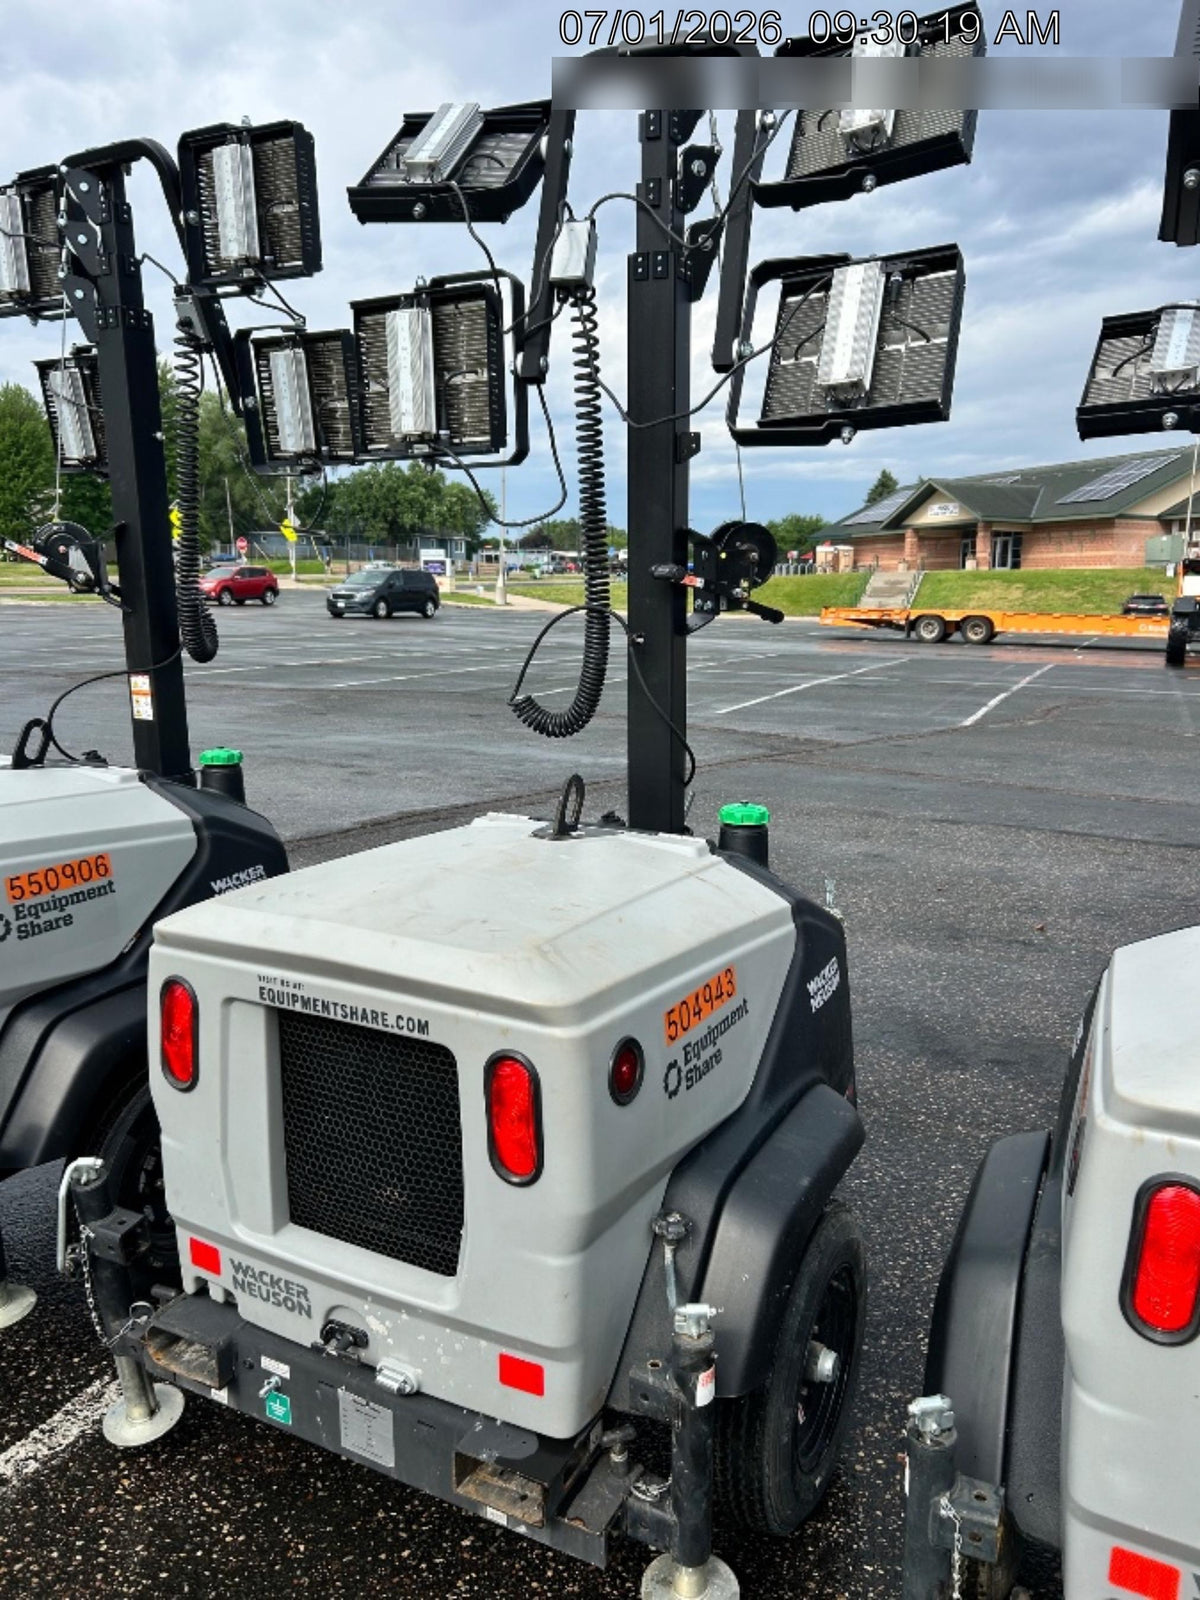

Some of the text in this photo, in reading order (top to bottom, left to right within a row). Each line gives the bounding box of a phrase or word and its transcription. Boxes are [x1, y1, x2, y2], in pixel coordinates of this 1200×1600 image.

[8, 854, 110, 901] 550906
[13, 879, 116, 921] Equipment
[210, 864, 267, 893] WACKER
[16, 912, 74, 941] Share
[258, 986, 430, 1036] EQUIPMENTSHARE.COM
[666, 967, 737, 1041] 504943
[682, 998, 750, 1066] Equipment
[684, 1048, 723, 1091] Share
[229, 1257, 310, 1302] WACKER
[232, 1274, 312, 1320] NEUSON
